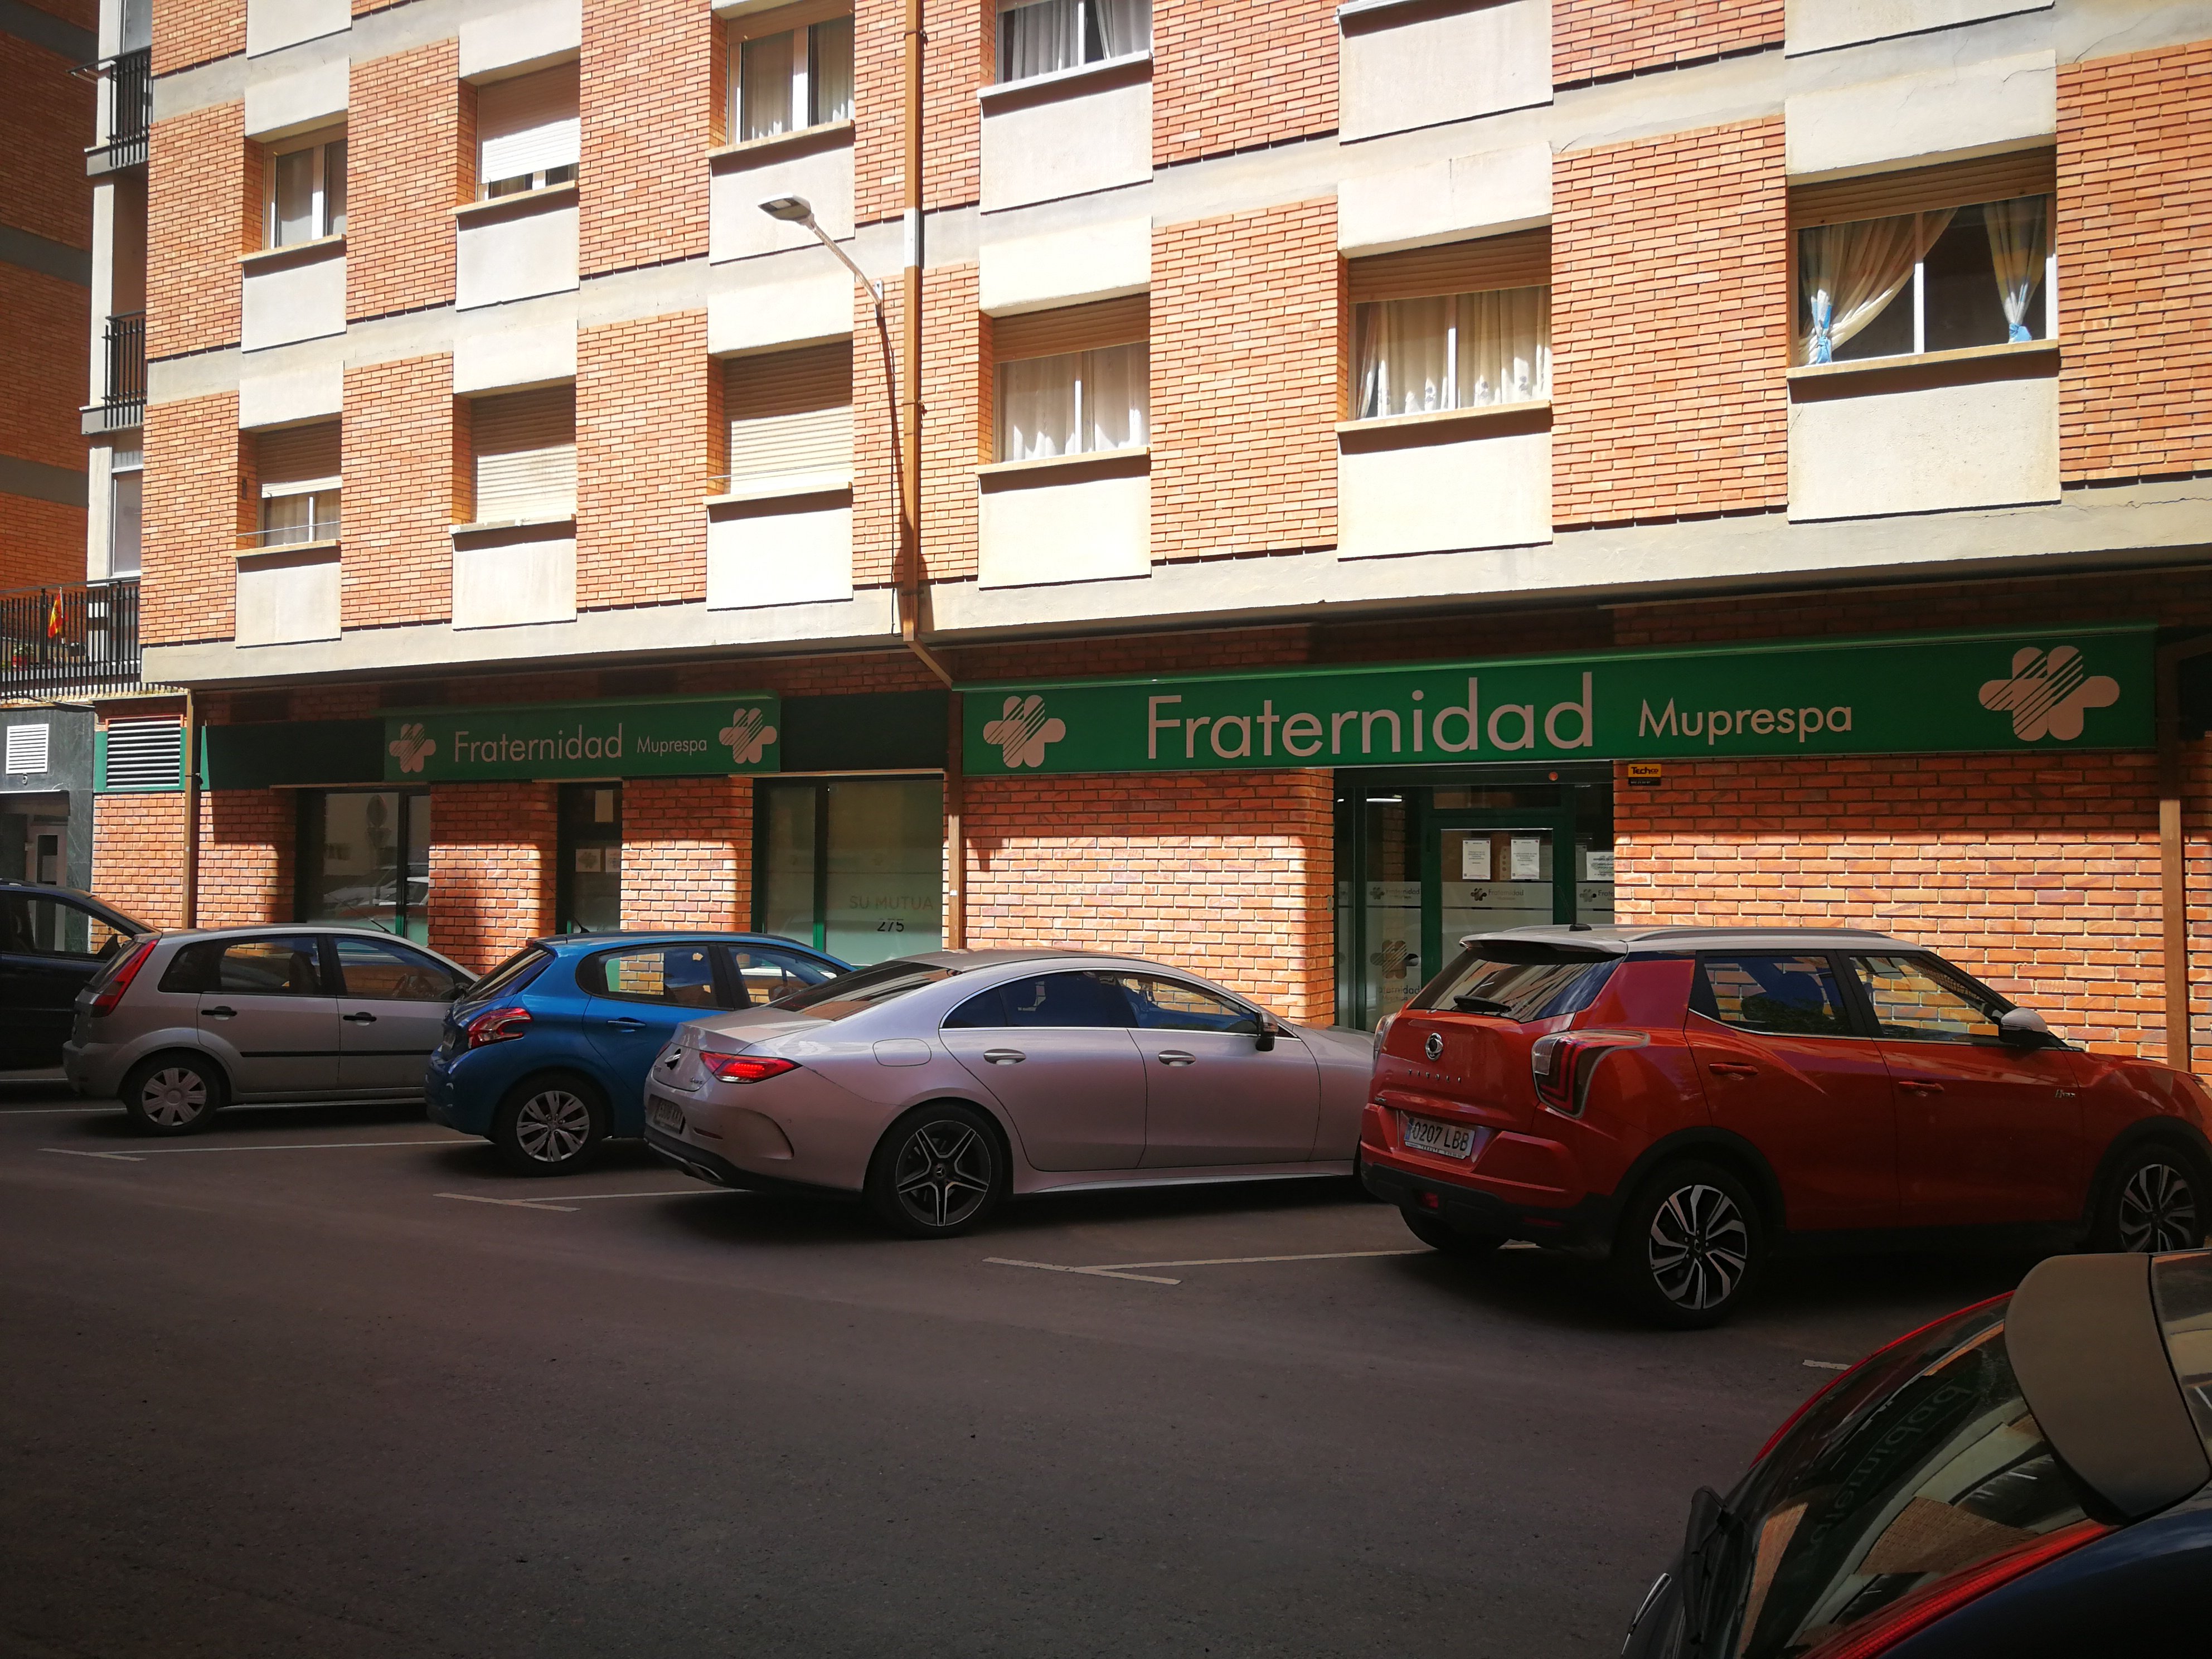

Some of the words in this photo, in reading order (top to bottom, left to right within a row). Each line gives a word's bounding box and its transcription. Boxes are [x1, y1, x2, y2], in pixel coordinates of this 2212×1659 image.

[1148, 671, 1593, 759] Fraternidad
[1639, 697, 1851, 745] Muprespa
[454, 722, 622, 762] Fraternidad
[637, 736, 707, 756] Muprespa
[850, 895, 869, 909] SU
[875, 896, 933, 910] MUTUA
[877, 918, 904, 932] 275
[1409, 1069, 1461, 1083] TIVOLI
[1412, 1122, 1443, 1144] 0207
